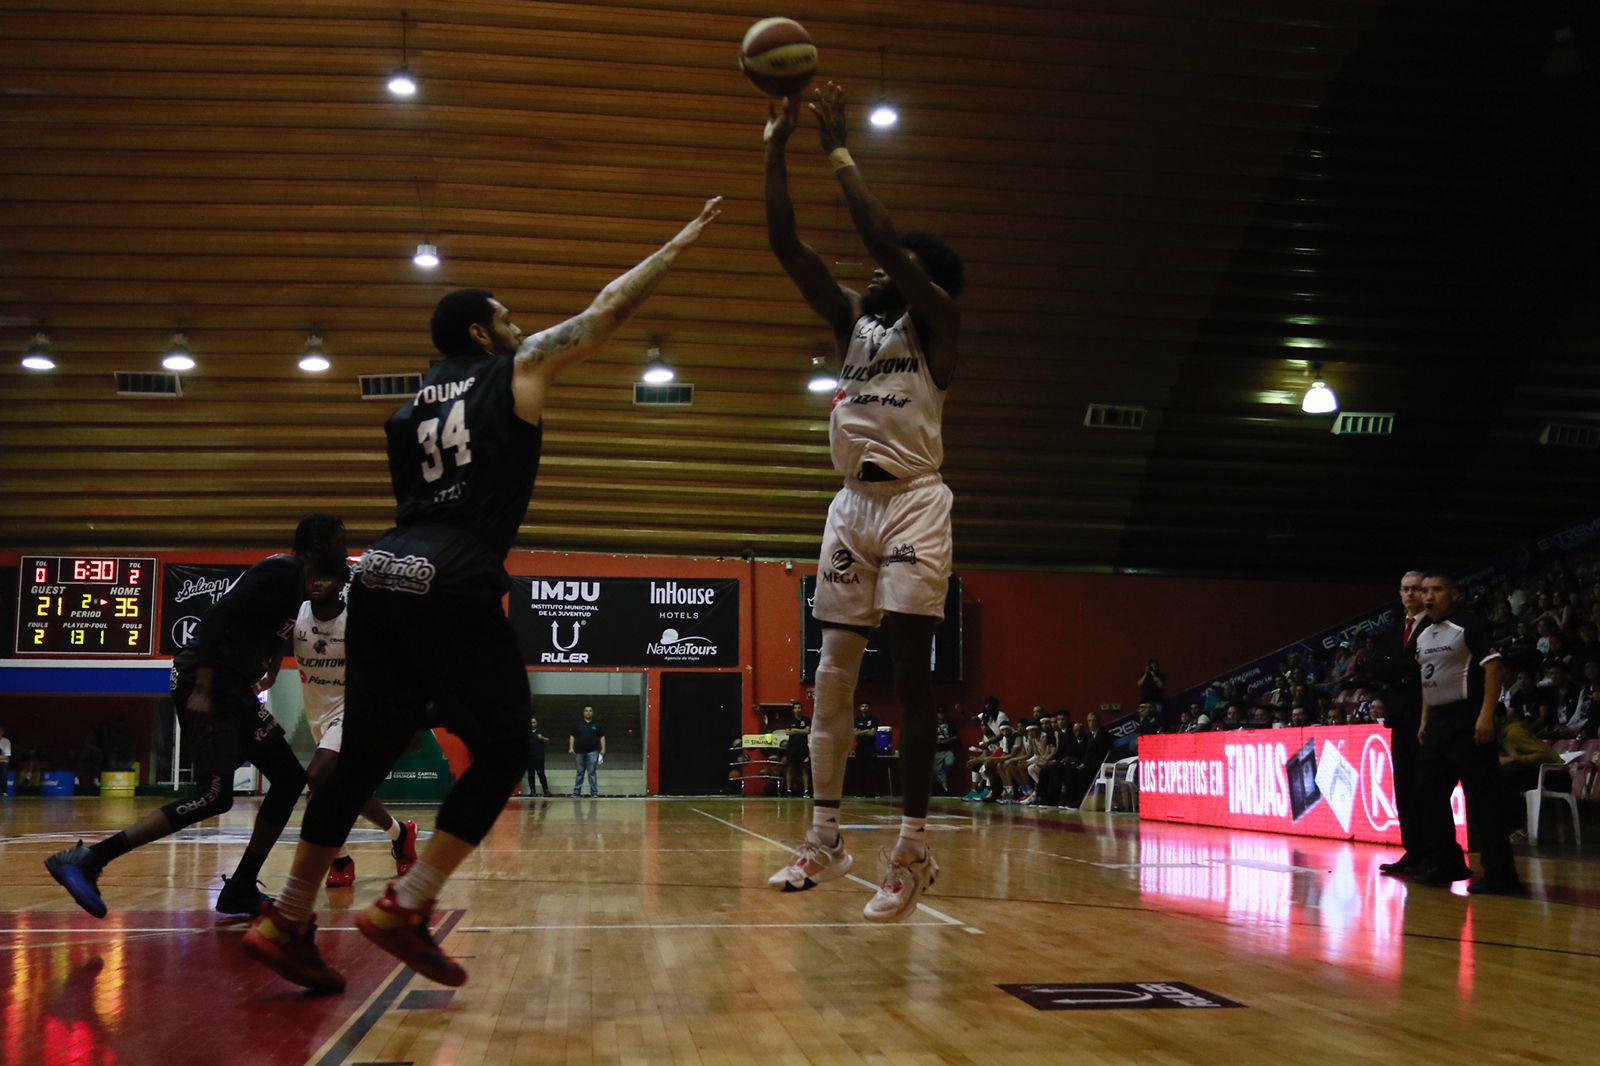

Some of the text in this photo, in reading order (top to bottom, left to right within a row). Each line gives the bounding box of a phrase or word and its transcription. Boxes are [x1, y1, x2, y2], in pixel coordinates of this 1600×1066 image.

[850, 394, 912, 408] izza Hut
[417, 400, 472, 483] 34
[35, 568, 46, 583] 0
[74, 560, 114, 580] 6:30
[129, 569, 140, 584] 2
[823, 572, 860, 584] MEGA
[31, 586, 66, 595] GUEST
[110, 587, 142, 596] HOME
[531, 580, 601, 602] IMJU
[649, 581, 715, 605] InHouse
[37, 596, 63, 617] 21
[82, 594, 92, 609] 2
[114, 597, 139, 618] 35
[531, 603, 599, 612] INSTITUTO MUNICIPAL
[70, 610, 101, 618] PERIOD
[659, 611, 700, 620] HOTELS
[63, 622, 108, 630] PLAYER-FOUL
[182, 620, 198, 645] K
[1322, 609, 1392, 649] ETREME
[34, 629, 45, 645] 2
[71, 629, 85, 645] 13
[99, 630, 105, 645] 1
[128, 630, 139, 646] 2
[646, 642, 717, 657] NavolaTours
[541, 653, 590, 663] RULER
[1139, 760, 1225, 796] LOS EXPERTOS EN
[1224, 742, 1288, 817] TARJAS
[1370, 748, 1396, 818] K
[176, 796, 209, 815] PRO
